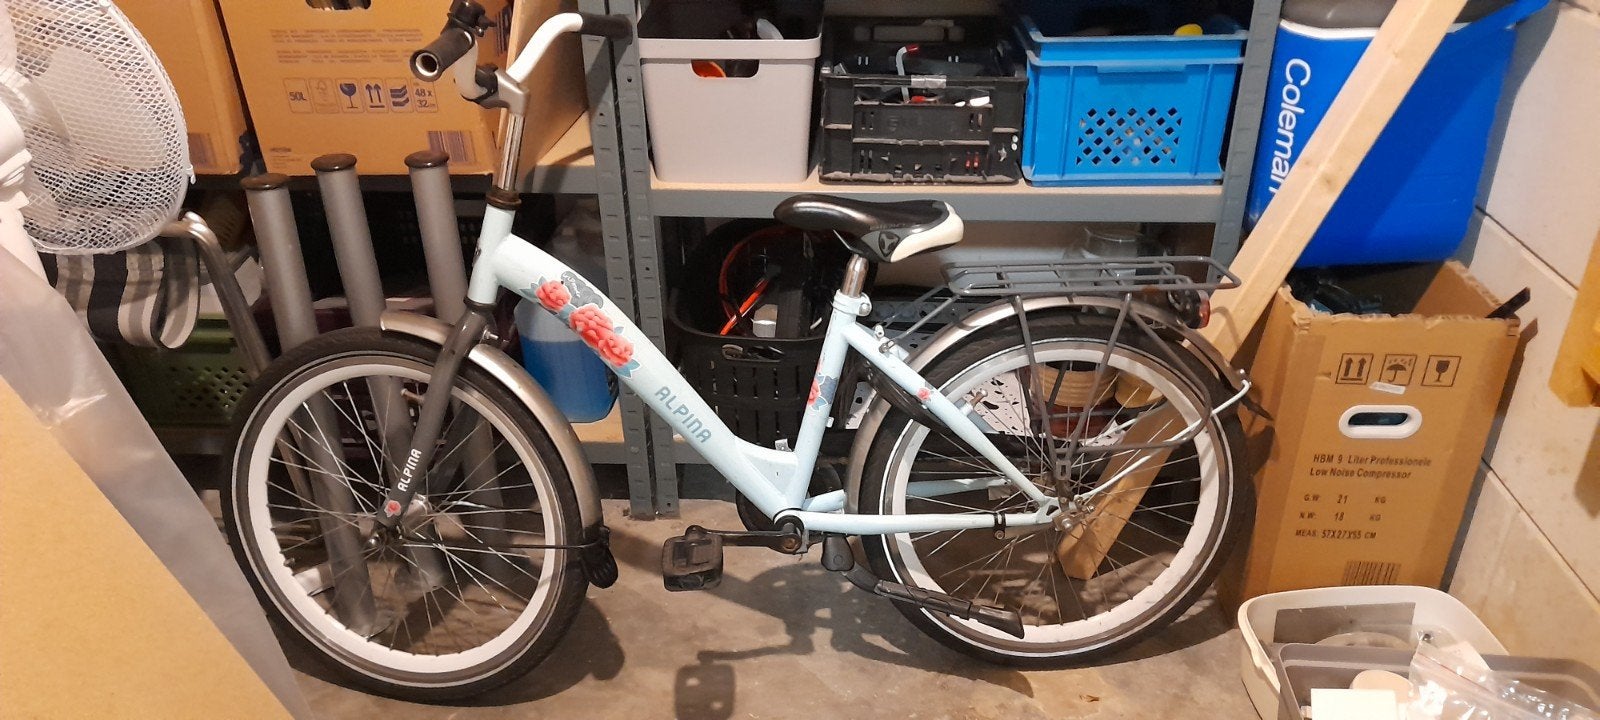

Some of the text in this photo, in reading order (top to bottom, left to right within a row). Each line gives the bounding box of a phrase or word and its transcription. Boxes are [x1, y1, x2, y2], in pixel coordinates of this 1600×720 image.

[289, 91, 307, 101] 50L
[415, 88, 426, 97] 48
[417, 99, 429, 108] 32
[655, 386, 712, 443] ALPINA
[1313, 454, 1432, 467] HBM 9 Liter Professionele
[397, 448, 422, 492] ALPINA
[1309, 467, 1412, 480] Low Noise Compressor
[1337, 494, 1348, 504] 21
[1374, 496, 1386, 504] KG
[1334, 511, 1345, 521] 18
[1364, 531, 1377, 540] CM
